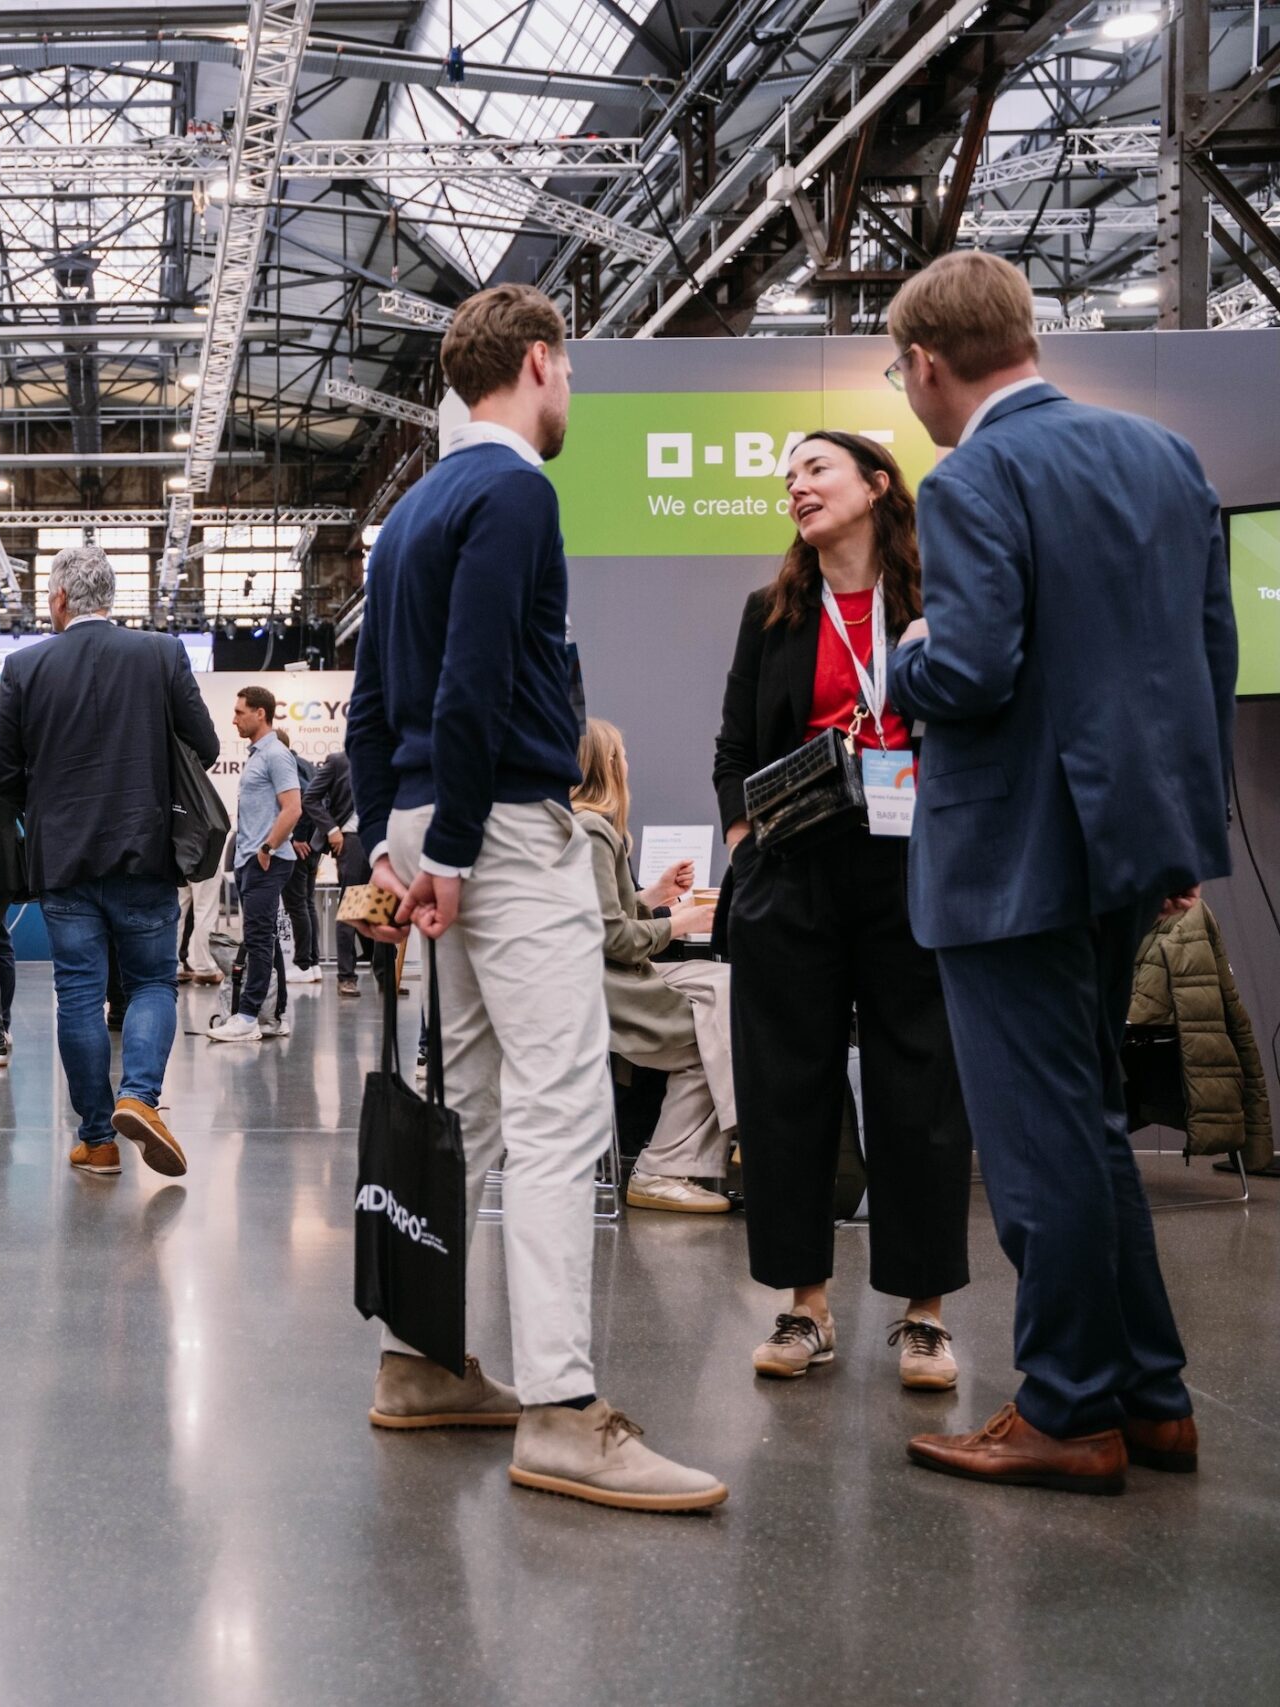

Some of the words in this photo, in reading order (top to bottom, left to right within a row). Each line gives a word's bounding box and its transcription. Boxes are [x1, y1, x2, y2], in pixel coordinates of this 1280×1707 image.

[648, 495, 686, 516] We
[693, 495, 768, 516] create
[299, 726, 320, 734] From
[323, 726, 340, 734] Old
